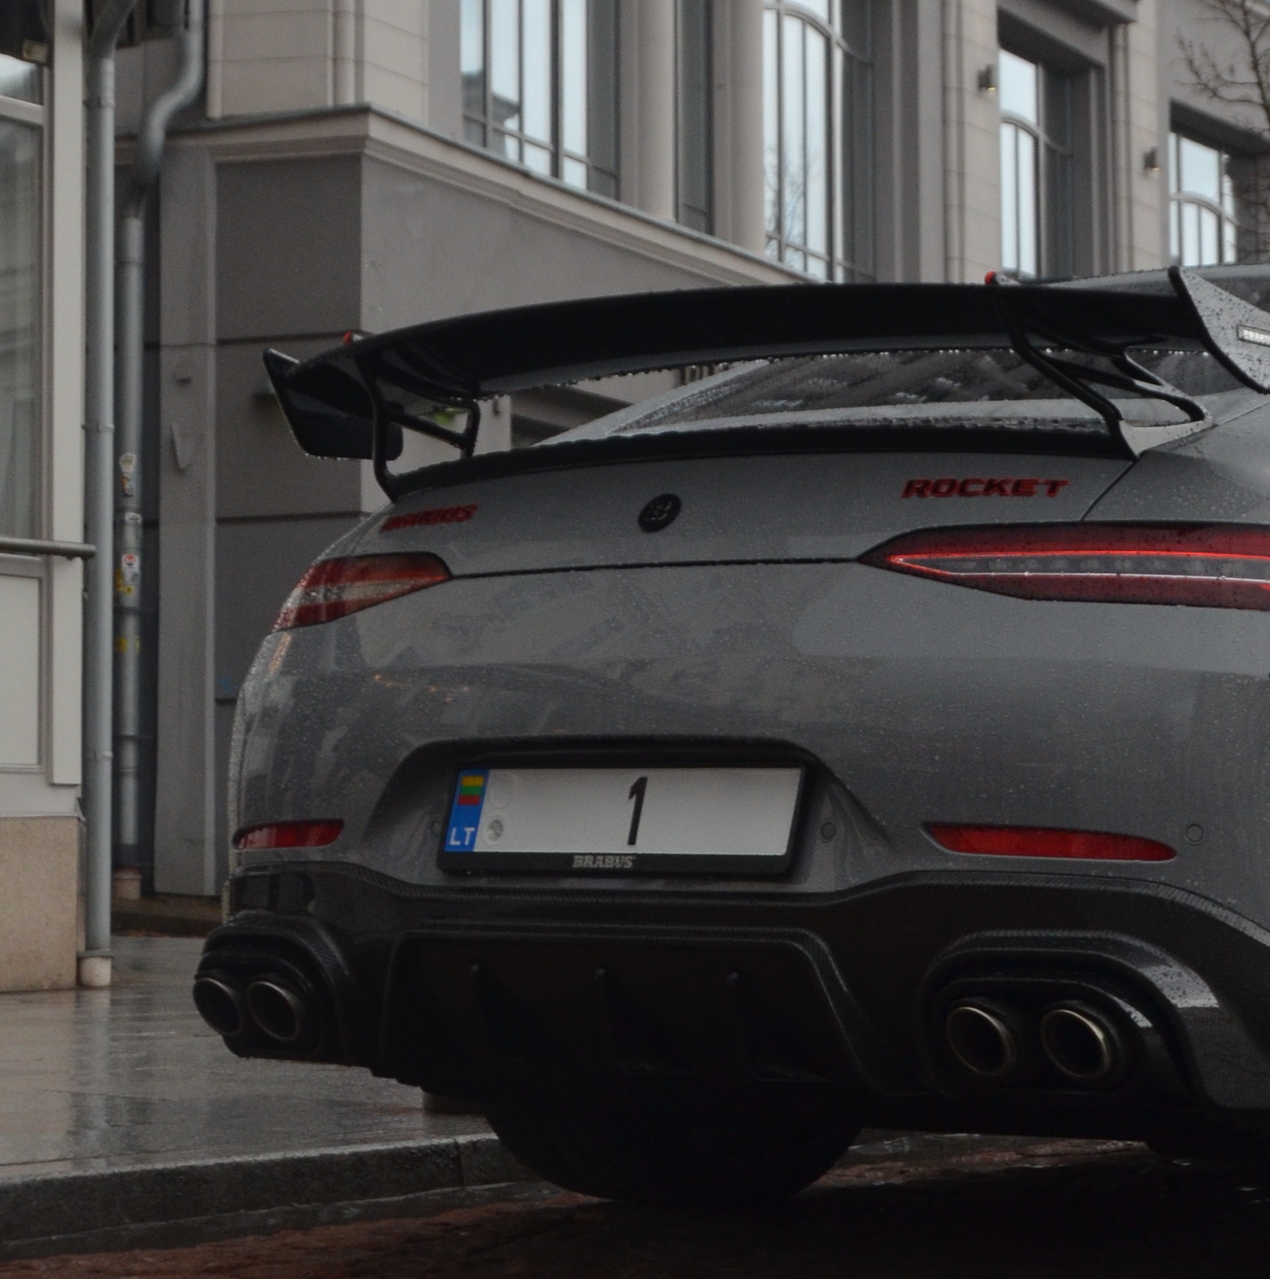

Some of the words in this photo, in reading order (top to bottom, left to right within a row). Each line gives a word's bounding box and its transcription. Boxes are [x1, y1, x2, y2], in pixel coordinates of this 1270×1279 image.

[902, 478, 1069, 497] ROCKET
[628, 777, 647, 845] 1
[450, 827, 474, 845] LT
[573, 855, 634, 869] BRABUS
